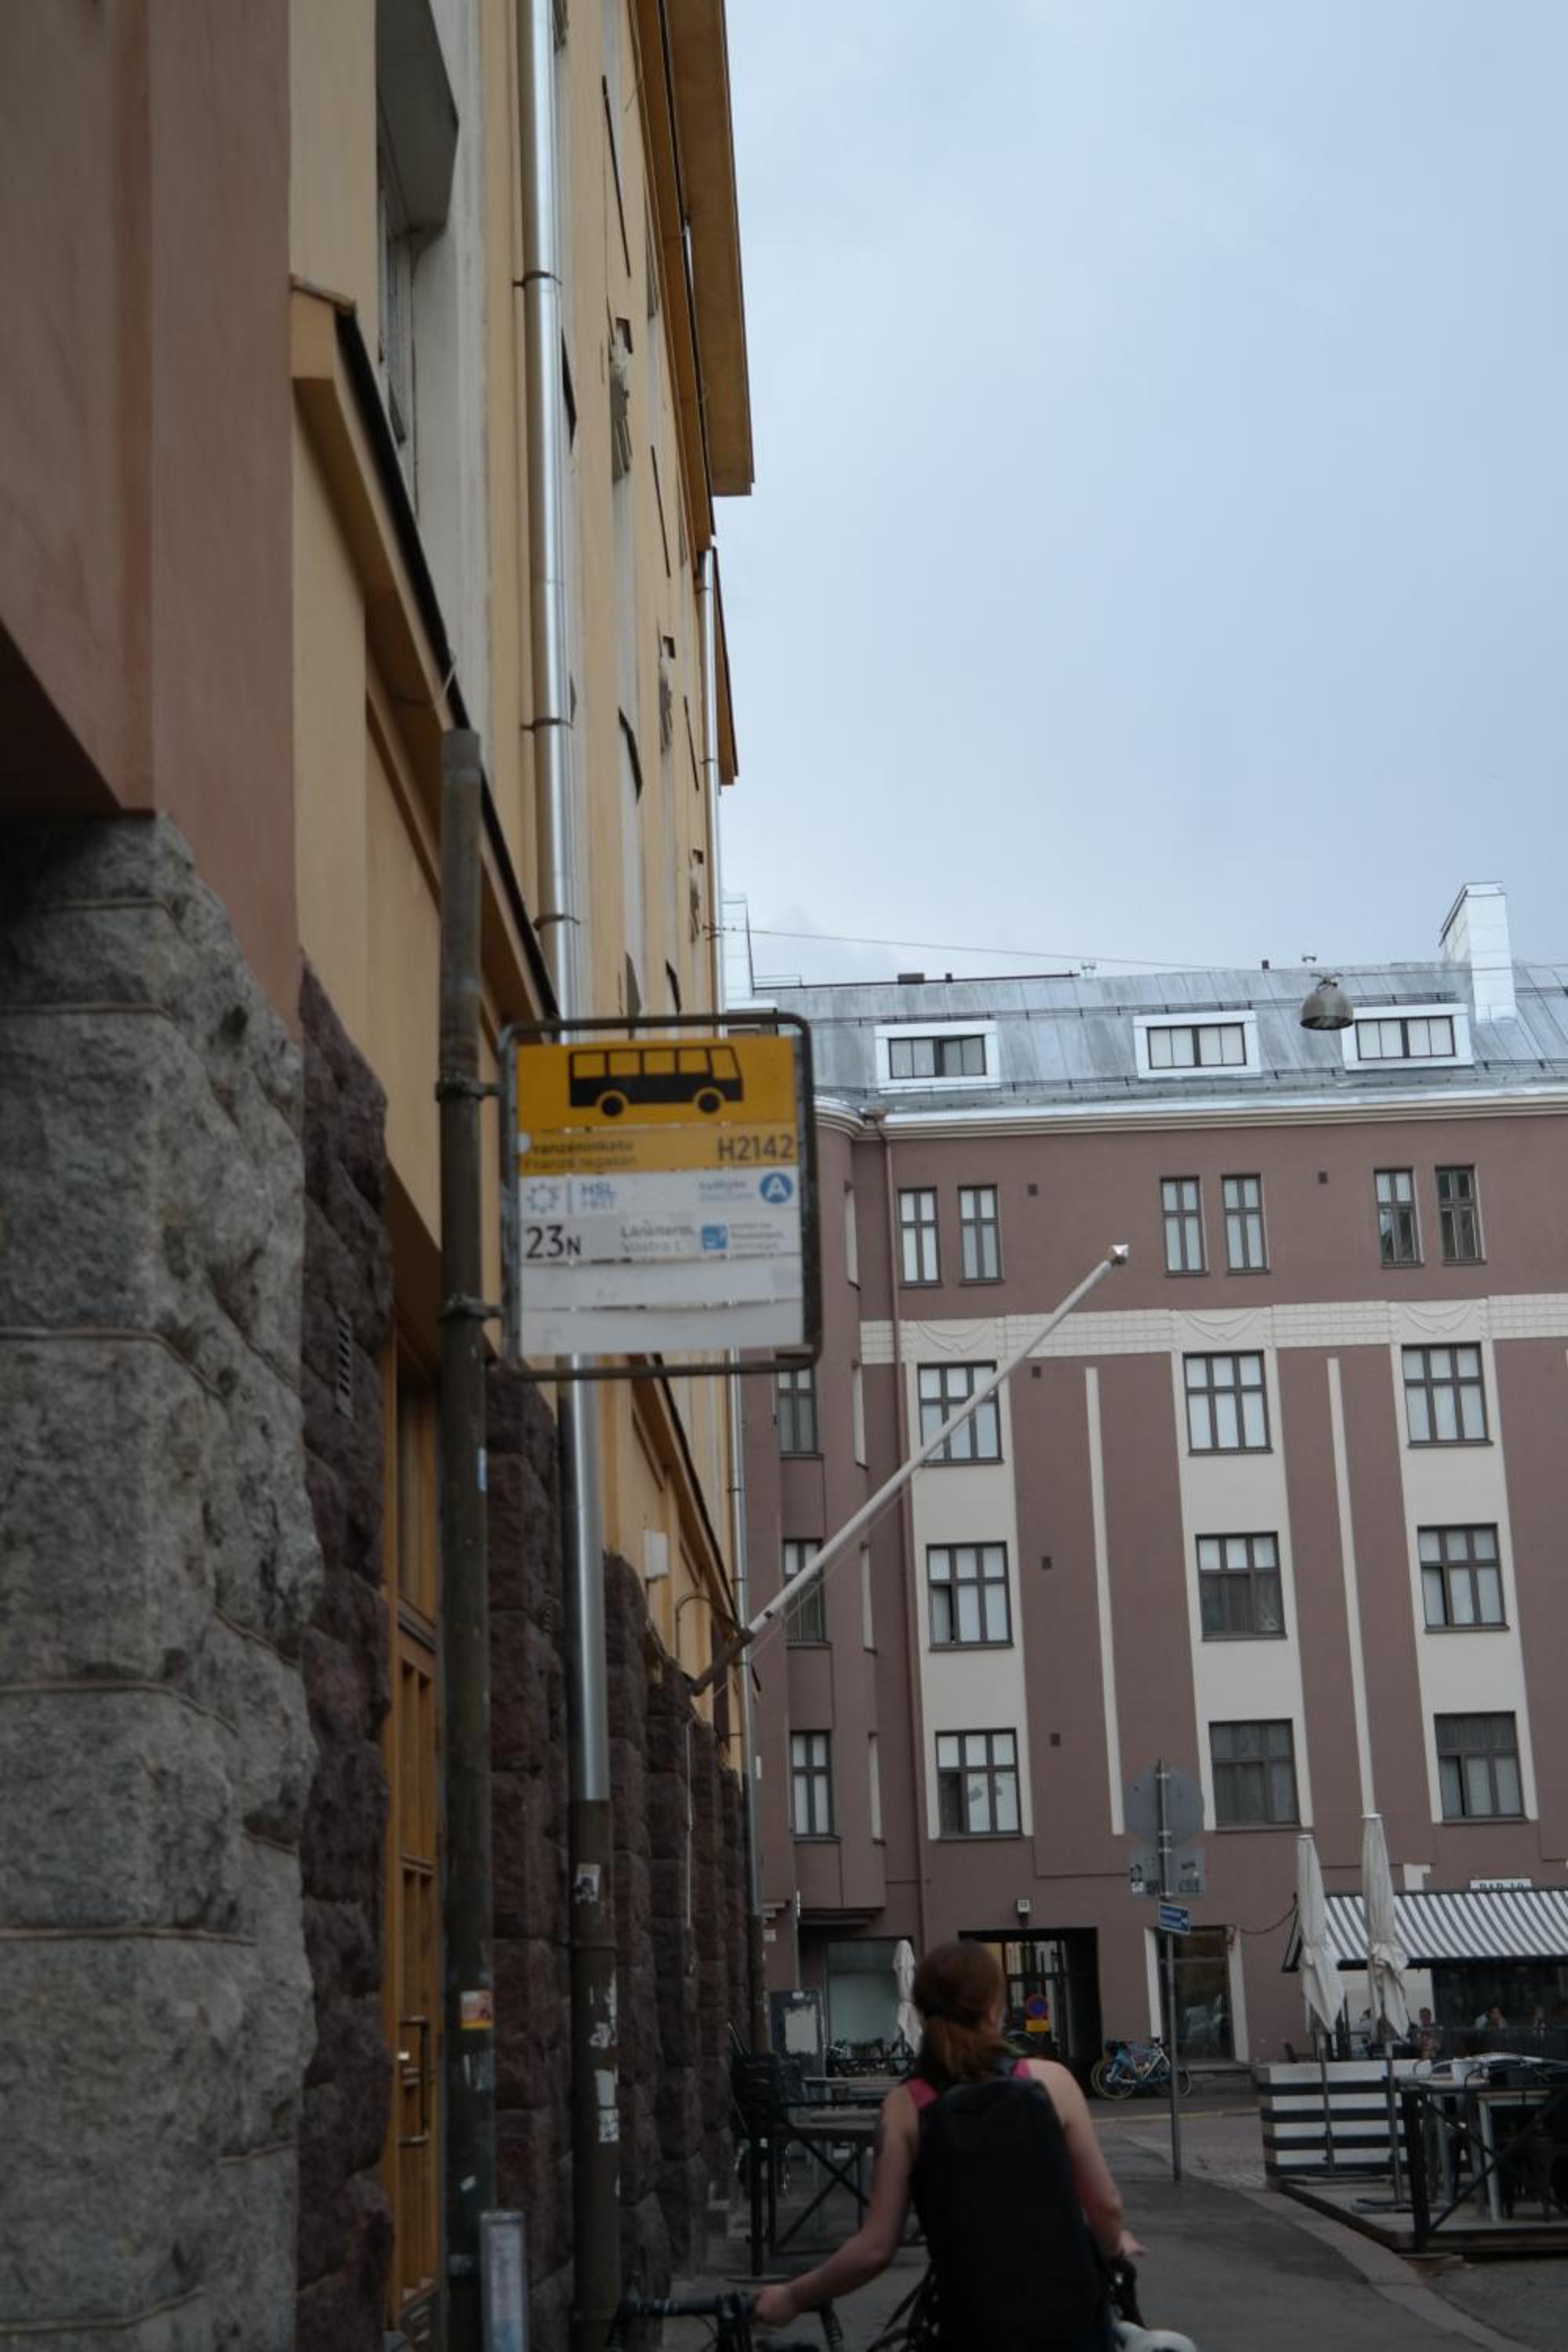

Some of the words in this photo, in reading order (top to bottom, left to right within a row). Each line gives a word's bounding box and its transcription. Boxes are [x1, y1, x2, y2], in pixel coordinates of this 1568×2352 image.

[718, 1134, 794, 1161] H2142
[581, 1181, 616, 1196] HSL
[526, 1224, 582, 1259] 23N
